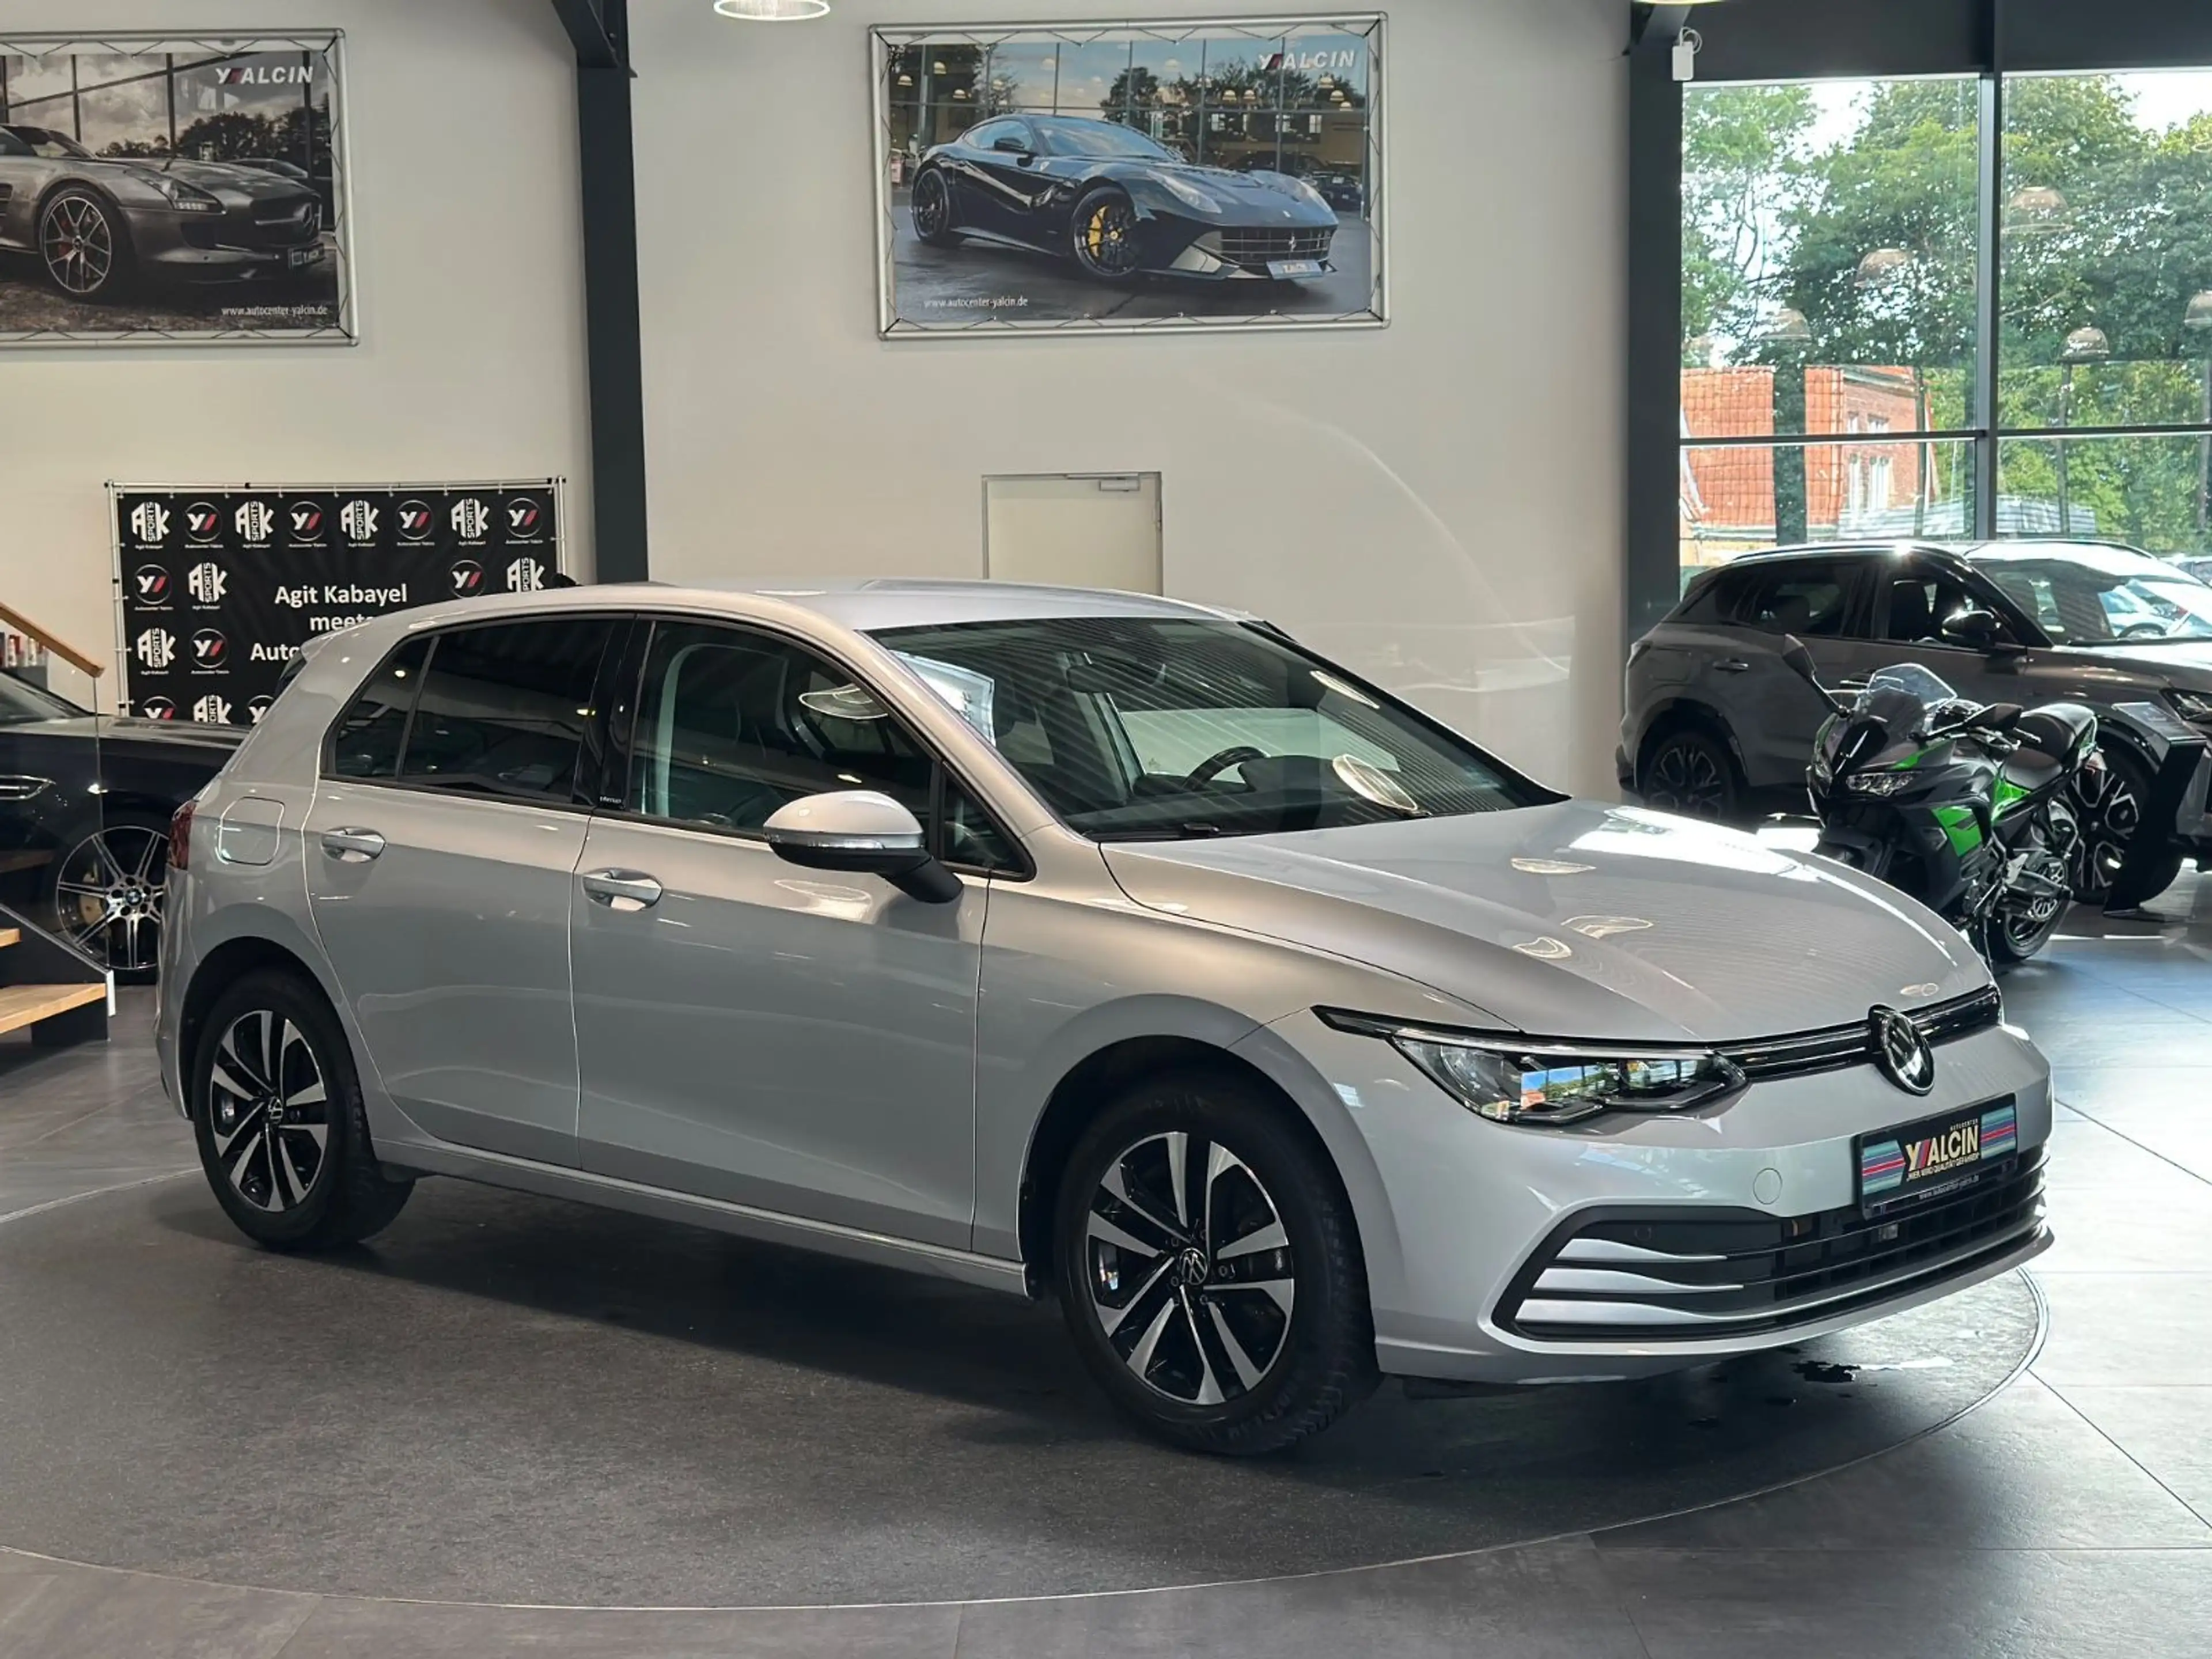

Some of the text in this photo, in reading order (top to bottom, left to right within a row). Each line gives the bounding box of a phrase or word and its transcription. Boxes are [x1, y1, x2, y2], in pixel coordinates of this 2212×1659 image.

[275, 584, 407, 608] Agit Kabayel
[1906, 1124, 1979, 1172] YALCIN
